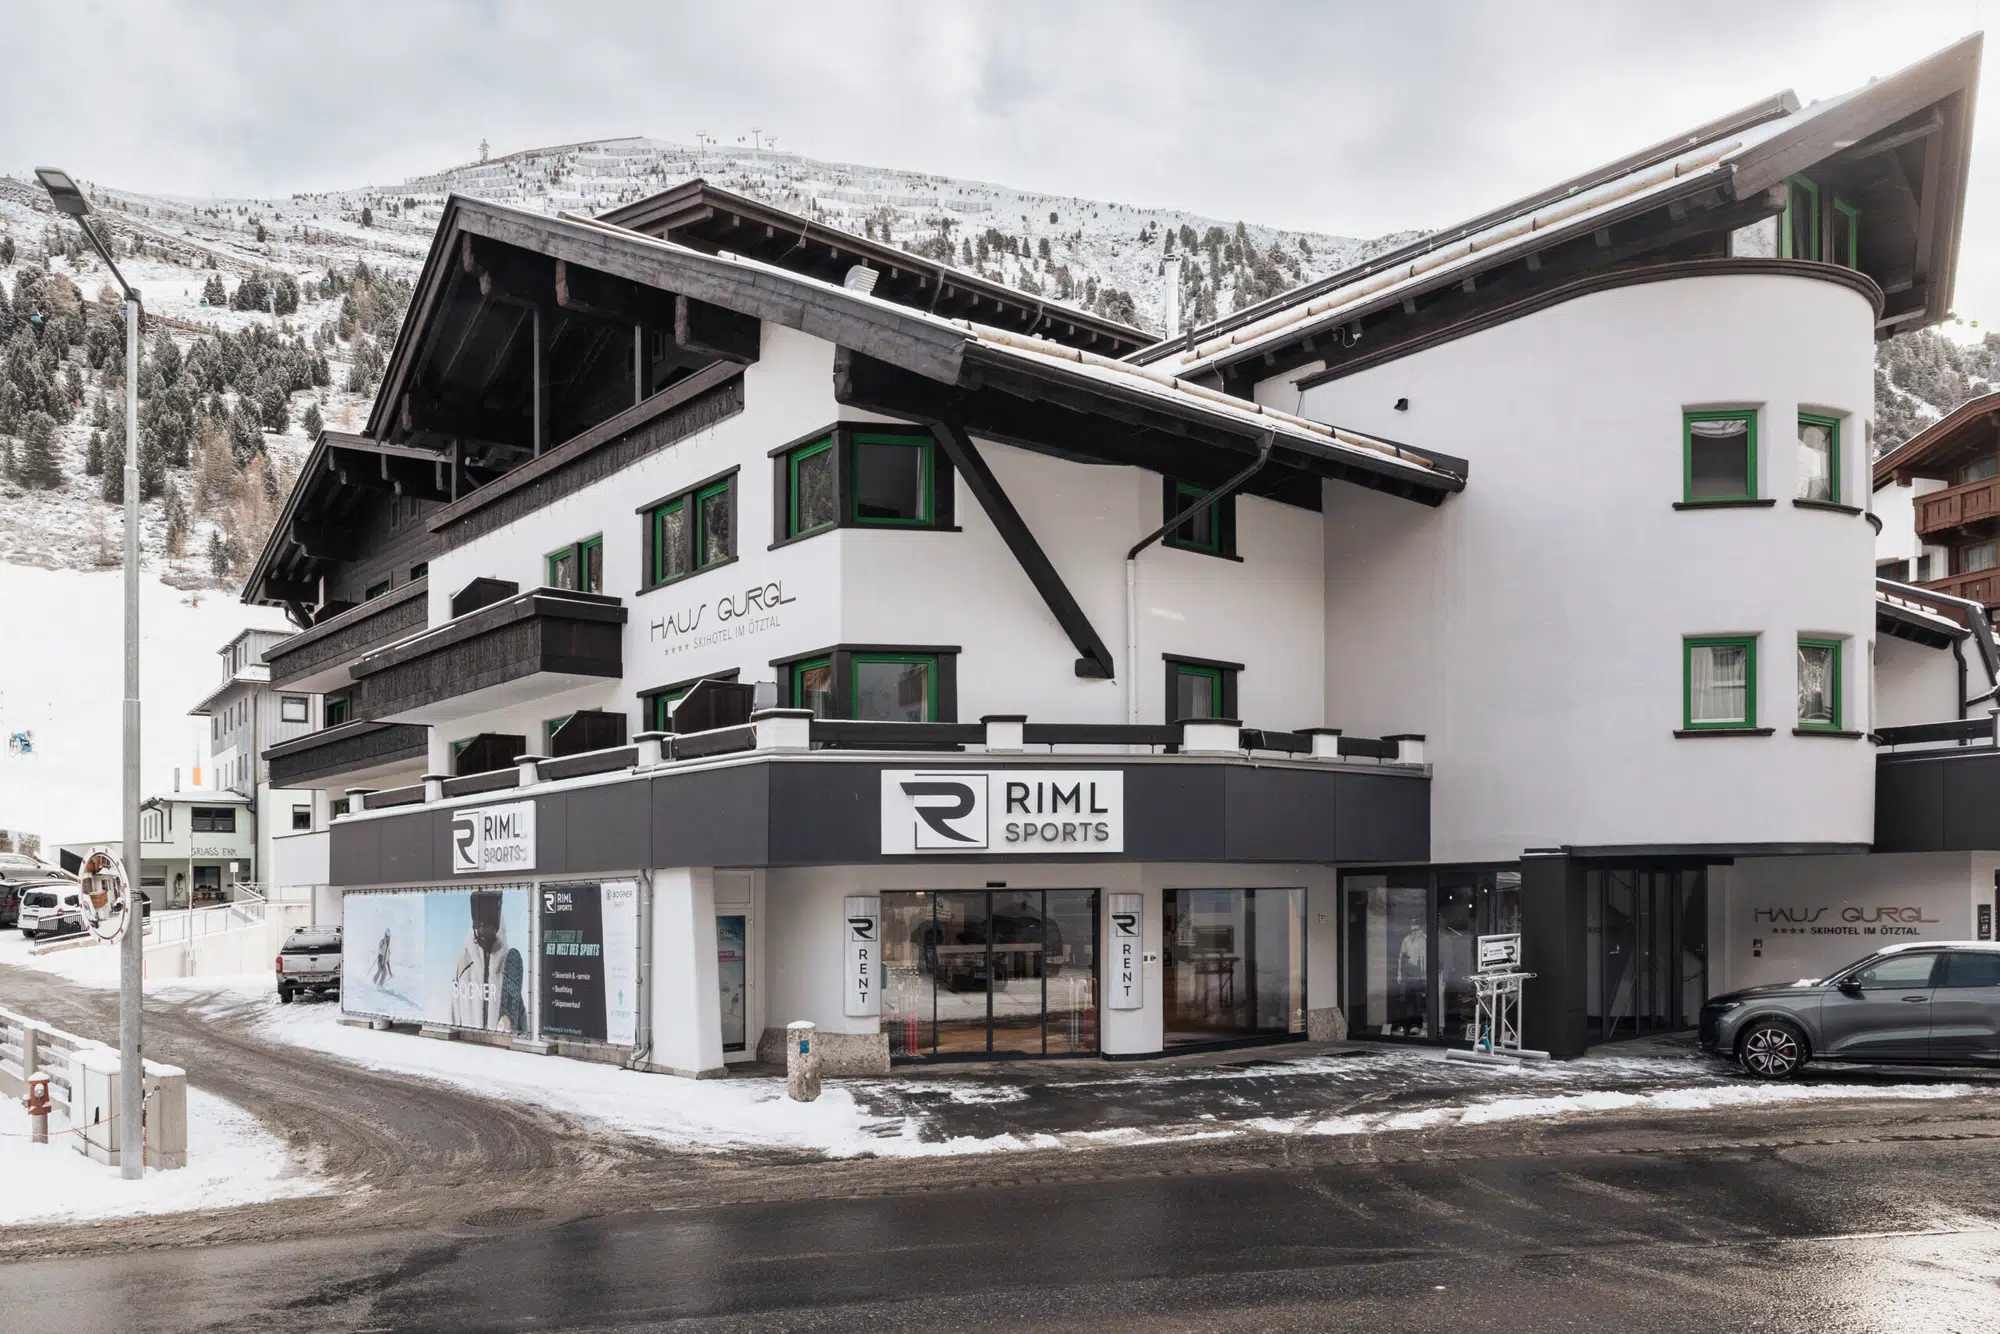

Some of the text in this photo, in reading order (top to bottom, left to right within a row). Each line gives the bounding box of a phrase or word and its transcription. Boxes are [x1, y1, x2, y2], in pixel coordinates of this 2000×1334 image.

[651, 580, 797, 642] HAUS GURGL
[693, 616, 781, 649] SKIHOTEL IM ÖTZTAL
[1005, 781, 1109, 815] RIML
[484, 813, 521, 841] RIML
[1005, 822, 1109, 843] SPORTS
[191, 847, 238, 856] GRIASS ENK
[484, 845, 521, 863] SPORTS
[557, 893, 573, 903] RIML
[557, 904, 573, 912] SPORTS
[1754, 907, 1940, 923] HAUS GURGL
[1811, 924, 1920, 935] SKIHOTEL IM ÖTZTAL
[556, 943, 569, 955] WELT
[569, 943, 579, 956] DES
[580, 943, 600, 956] SPORTS
[858, 949, 868, 1003] RENT
[1123, 944, 1132, 997] RENT
